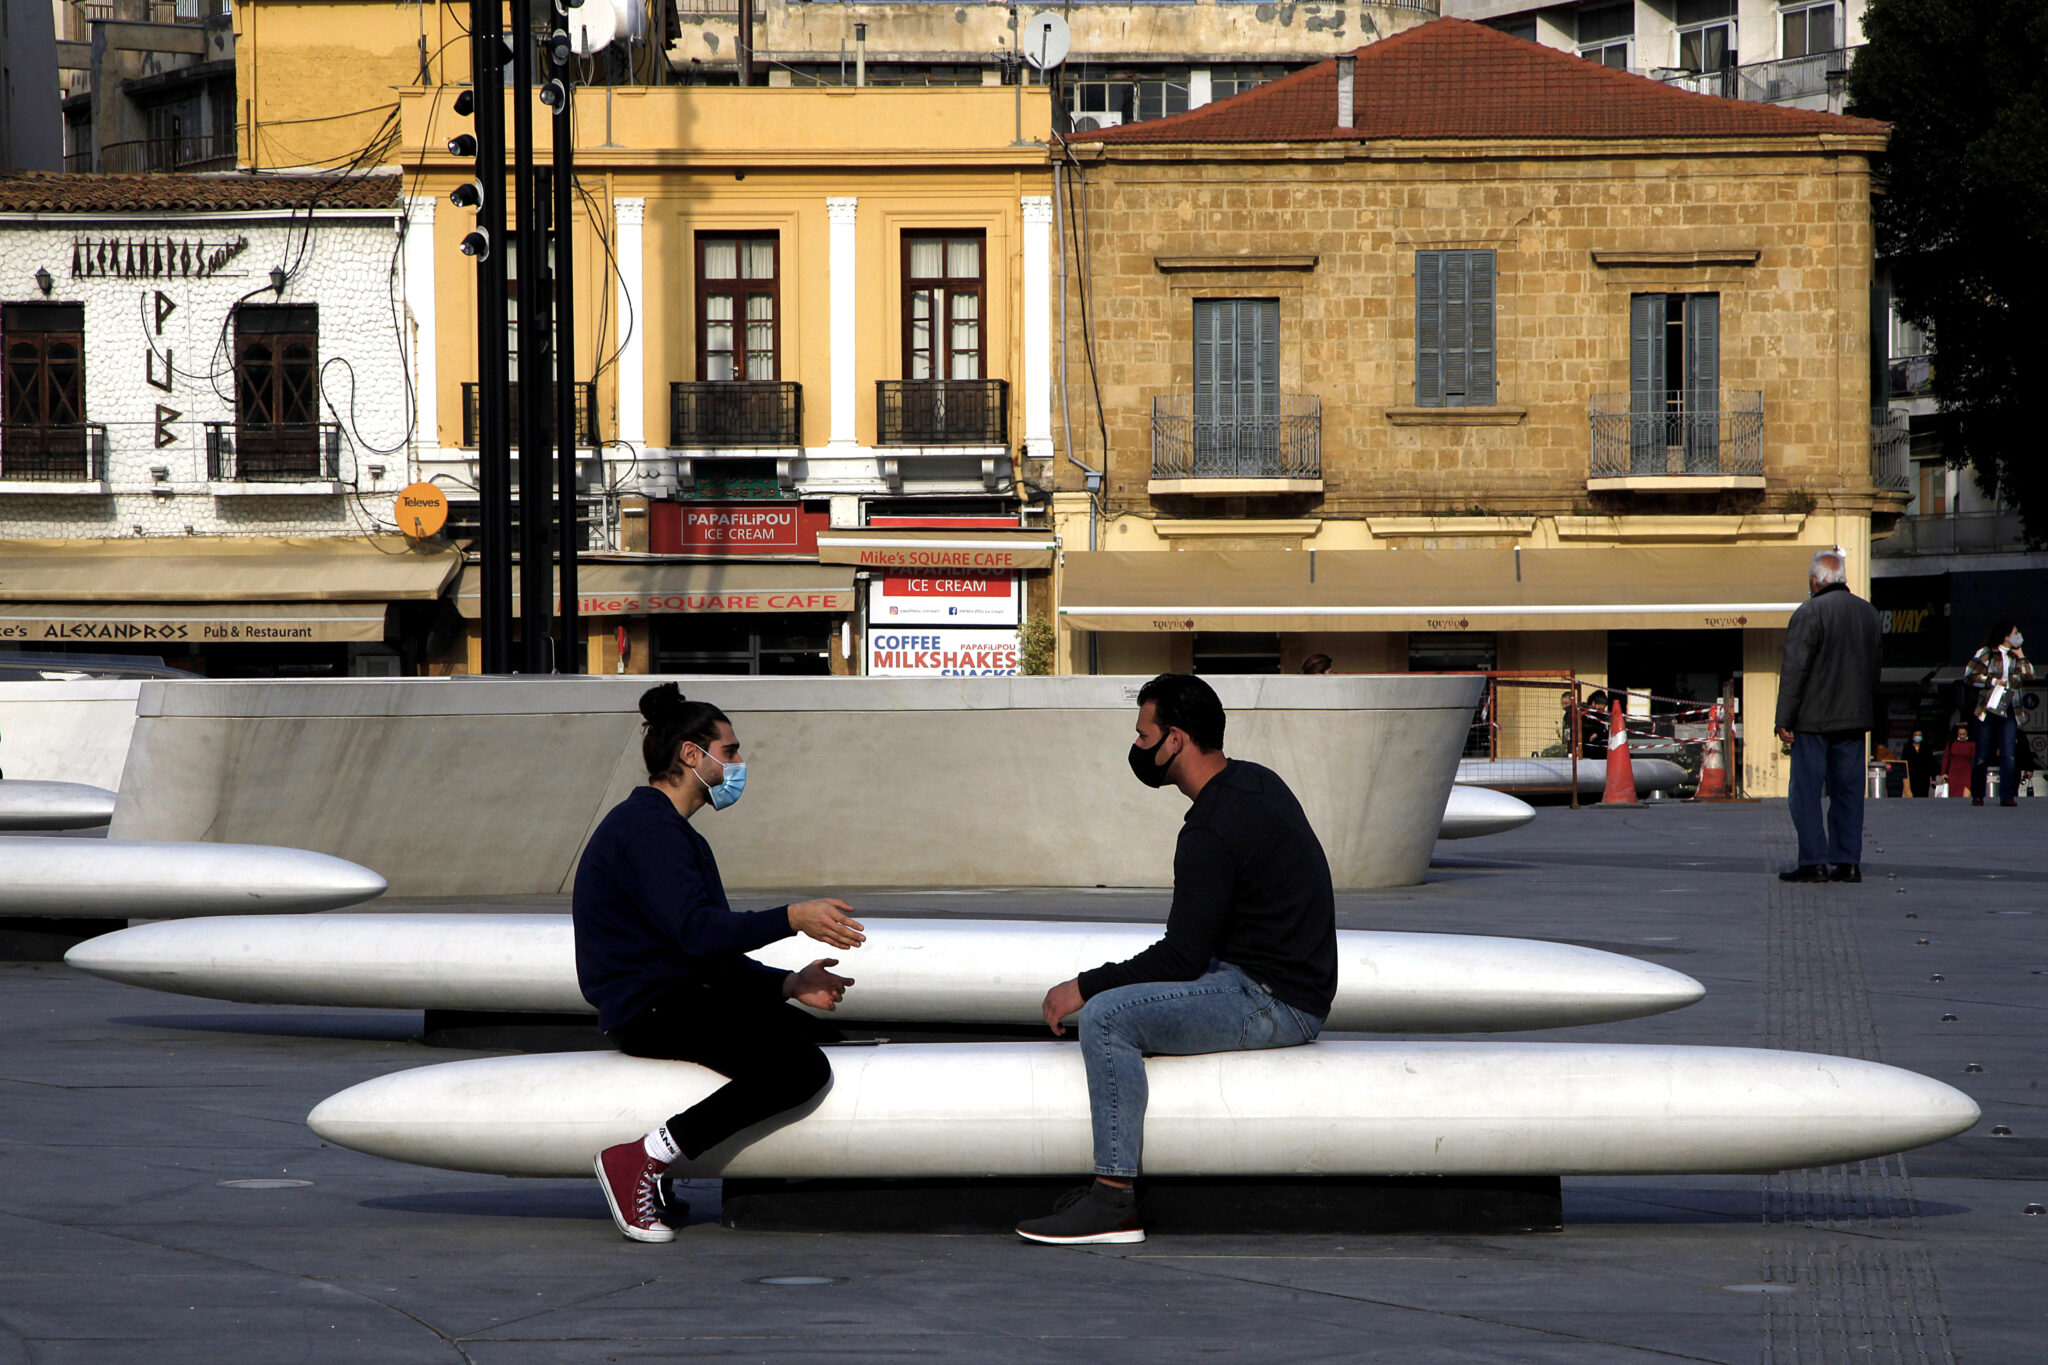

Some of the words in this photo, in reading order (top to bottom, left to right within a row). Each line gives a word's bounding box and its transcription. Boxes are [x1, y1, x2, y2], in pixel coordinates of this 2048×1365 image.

[146, 290, 182, 448] PUB
[753, 486, 777, 498] PUB
[402, 496, 440, 507] Televes
[704, 529, 722, 540] ICE
[729, 529, 774, 540] CREAM
[860, 550, 905, 565] Mike's
[909, 551, 971, 566] SQUARE
[974, 552, 1013, 566] CAFE
[908, 579, 929, 592] ICE
[935, 580, 986, 592] CREAM
[558, 597, 639, 613] ike's
[648, 596, 760, 611] SQUARE
[767, 595, 837, 609] CAFE
[1880, 609, 1928, 634] BWAY
[0, 625, 28, 637] e's
[44, 623, 189, 639] ALEXANDROS
[203, 625, 228, 637] Pub
[231, 626, 240, 637] &
[245, 625, 312, 637] Restaurant
[874, 635, 941, 650] COFFEE
[874, 651, 1017, 669] MILKSHAKES
